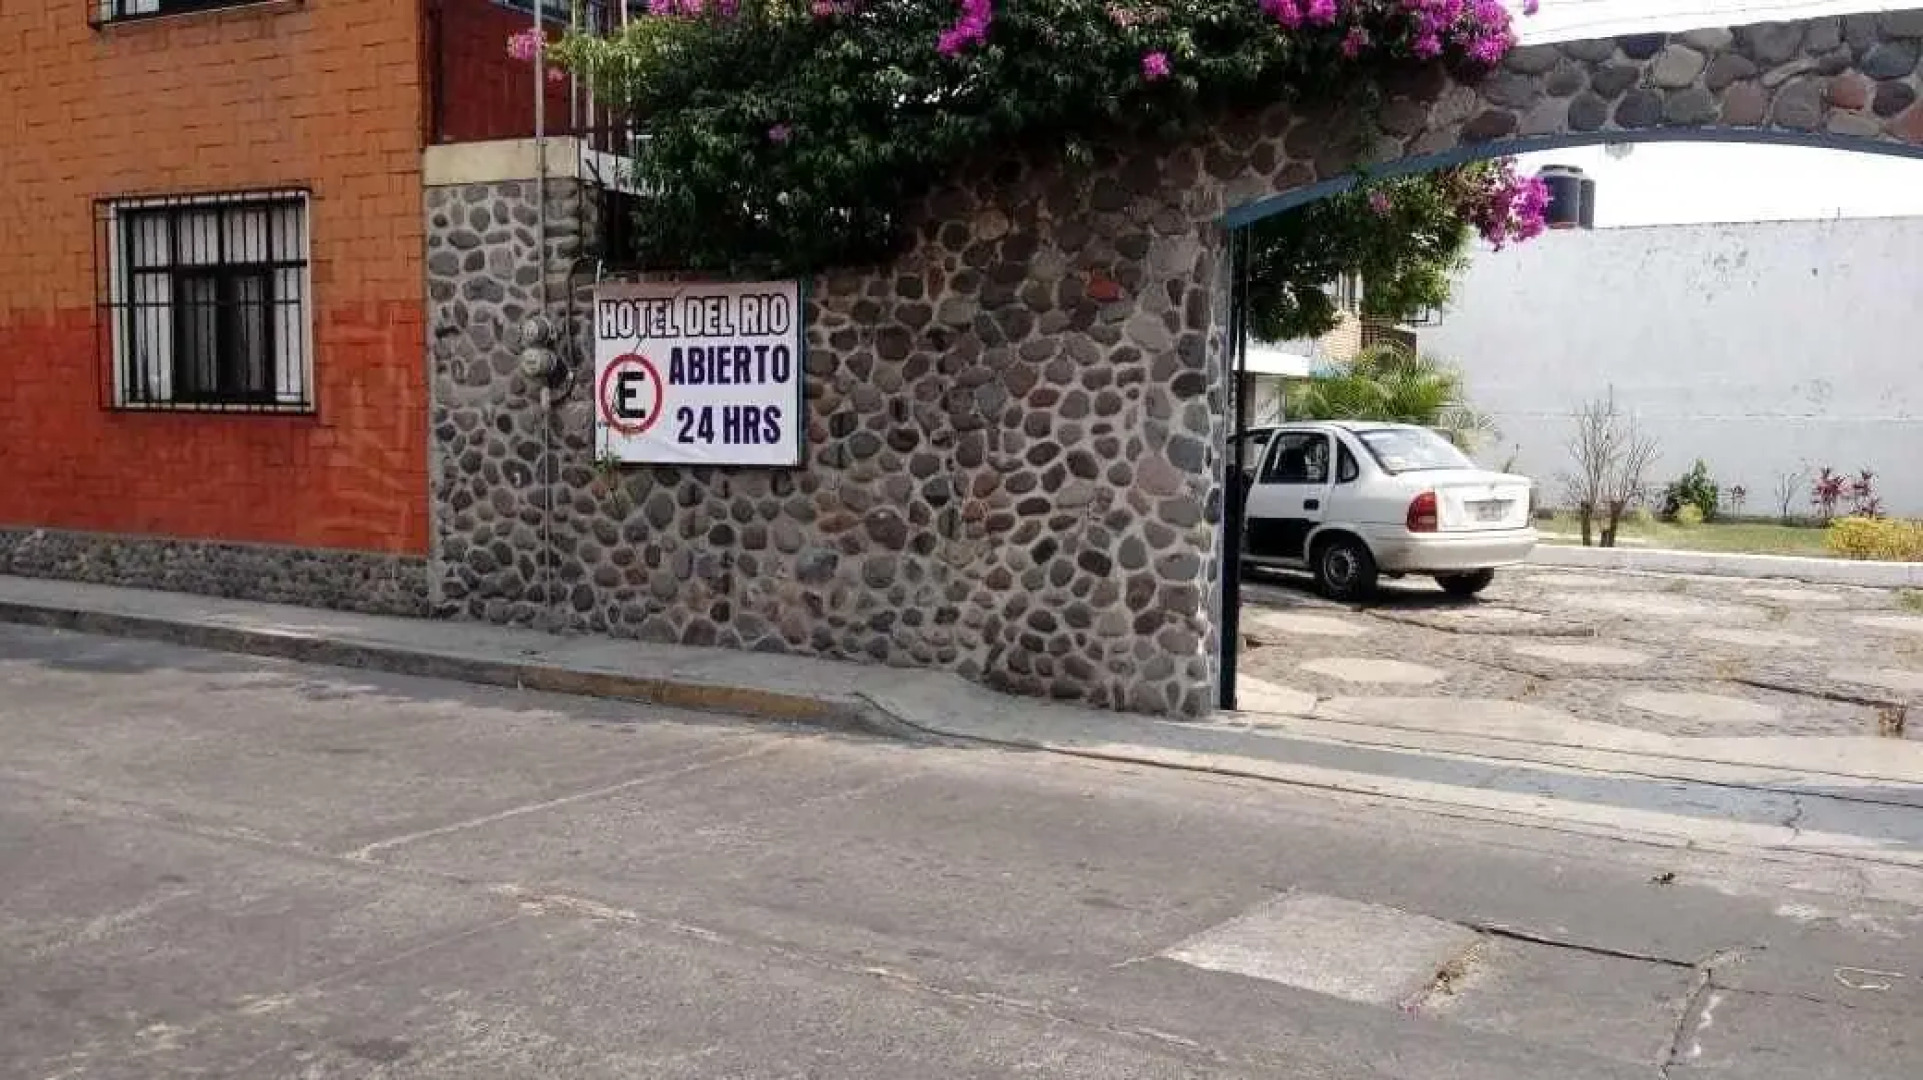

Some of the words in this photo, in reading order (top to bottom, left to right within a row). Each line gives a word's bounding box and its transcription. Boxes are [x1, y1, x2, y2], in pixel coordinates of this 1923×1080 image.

[600, 298, 679, 338] HOTEL
[685, 296, 734, 337] DEL
[740, 294, 790, 336] RIO
[669, 345, 790, 385] ABIERTO
[616, 371, 645, 418] E
[677, 406, 714, 444] 24
[723, 406, 782, 444] HRS
